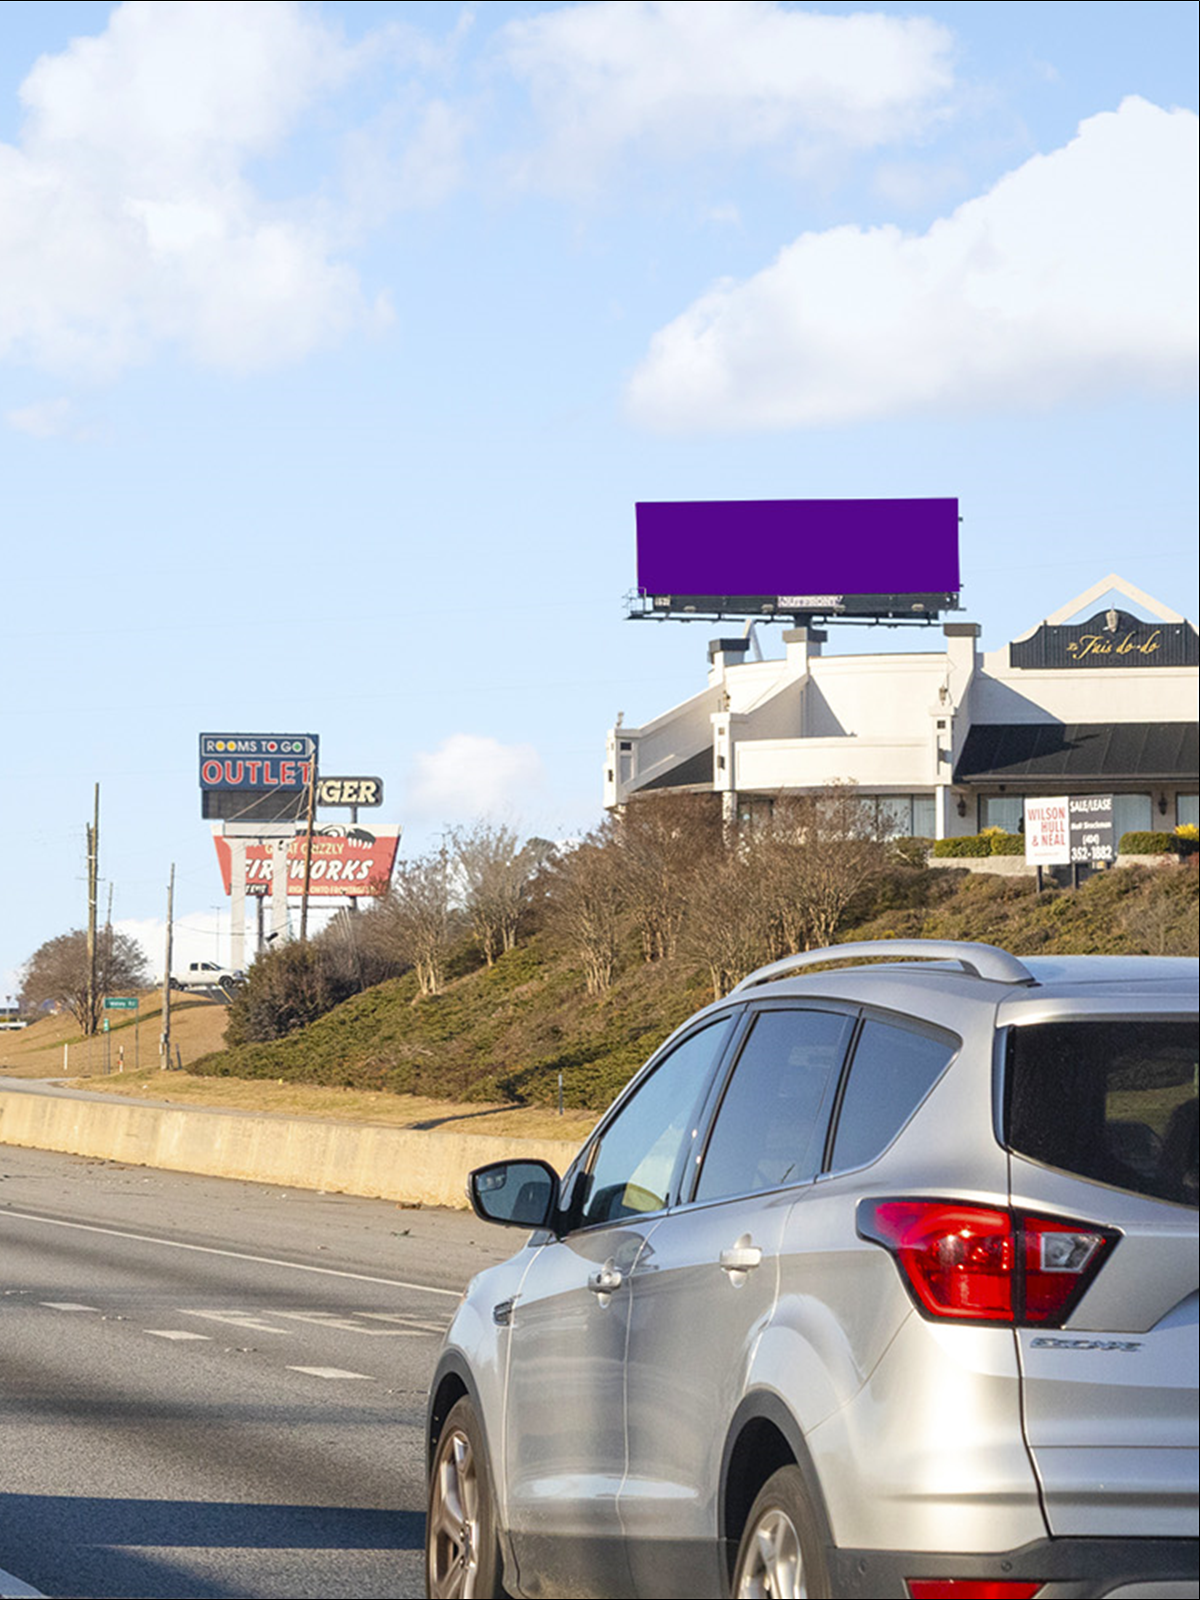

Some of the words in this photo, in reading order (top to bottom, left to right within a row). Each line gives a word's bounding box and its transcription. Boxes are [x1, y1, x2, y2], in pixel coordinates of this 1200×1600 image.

[206, 740, 257, 752] ROOMS
[261, 741, 277, 752] TO
[280, 741, 303, 753] GO
[202, 760, 311, 785] OUTLET
[317, 780, 377, 803] GER
[1069, 798, 1112, 813] SALE/LEASE
[1027, 806, 1066, 821] WILSON
[1041, 820, 1066, 833] HULL
[1031, 835, 1039, 847] &
[1041, 833, 1066, 846] NEAL
[265, 843, 298, 854] GAT
[245, 858, 374, 882] FIRWORKS
